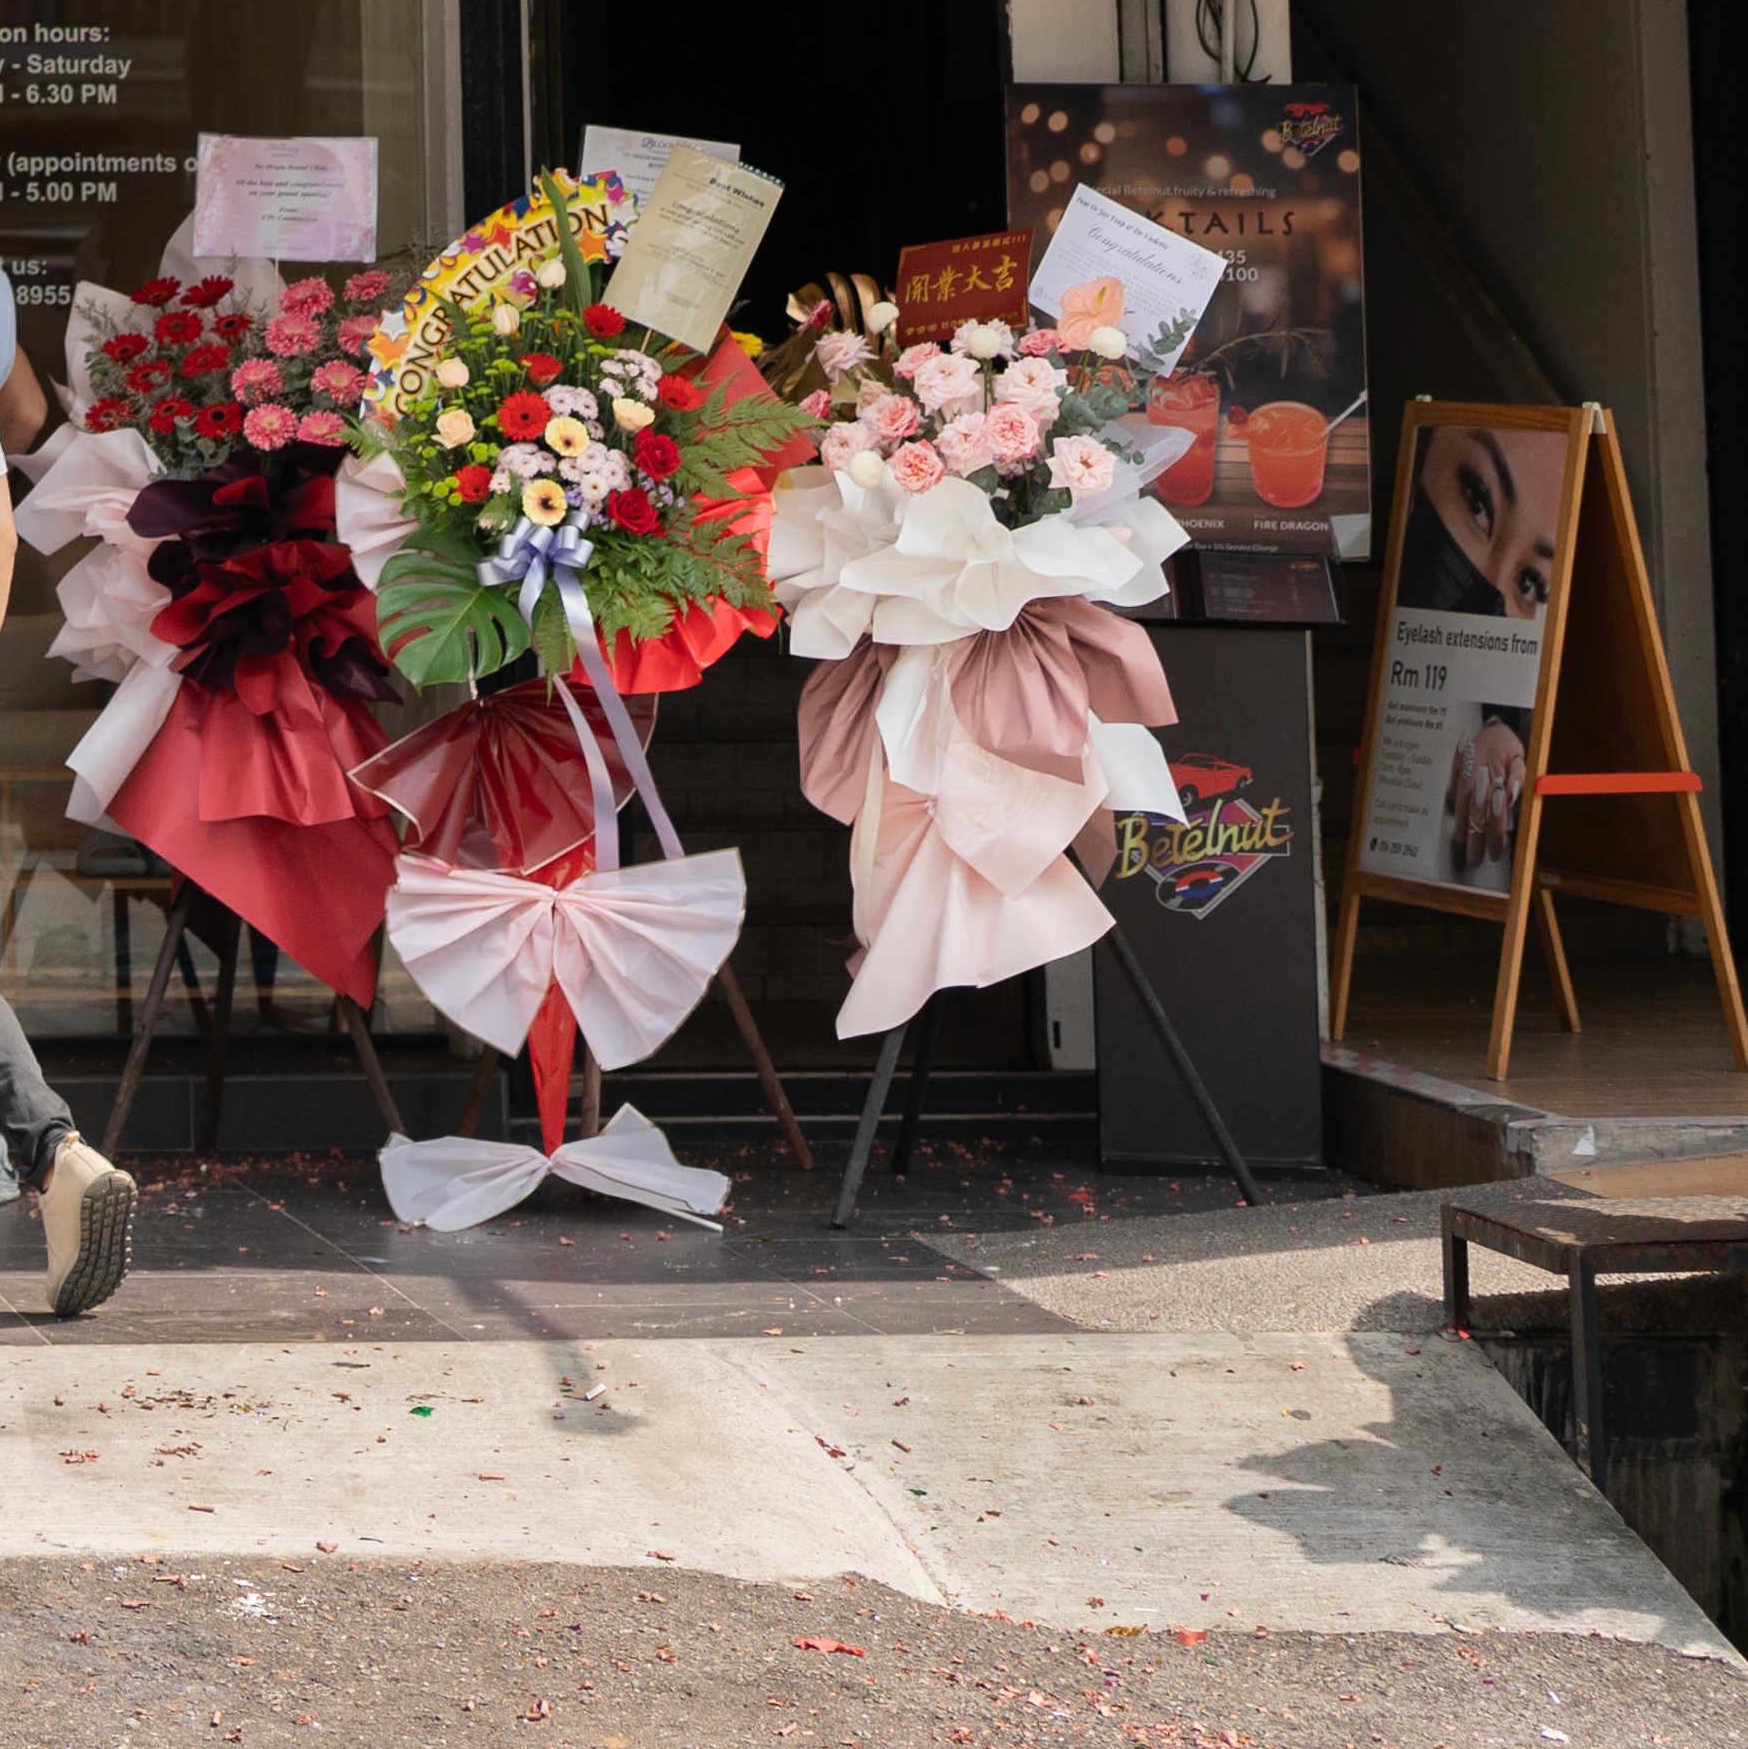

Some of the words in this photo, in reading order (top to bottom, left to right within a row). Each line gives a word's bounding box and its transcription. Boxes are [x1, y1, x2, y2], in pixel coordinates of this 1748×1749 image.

[34, 22, 111, 44] hours:
[26, 53, 132, 79] Saturday
[26, 83, 75, 104] 6.30
[81, 84, 118, 103] PM
[7, 151, 178, 177] (appointments
[26, 182, 75, 202] 5.00
[81, 182, 118, 202] PM
[731, 186, 767, 207] Wishes
[1217, 185, 1277, 199] refreshing
[1144, 209, 1296, 236] KTAILS
[11, 257, 48, 276] us:
[1083, 221, 1187, 291] Congratulations
[904, 252, 1018, 307] 開業大吉
[15, 285, 71, 305] 8955
[1253, 520, 1279, 532] FIRE
[1280, 520, 1330, 533] DRAGON
[1395, 620, 1444, 650] Eyelash
[1444, 627, 1510, 652] extensions
[1510, 633, 1539, 655] from
[1390, 660, 1421, 688] Rm
[1422, 663, 1448, 691] 119
[1114, 796, 1296, 880] Betelnut
